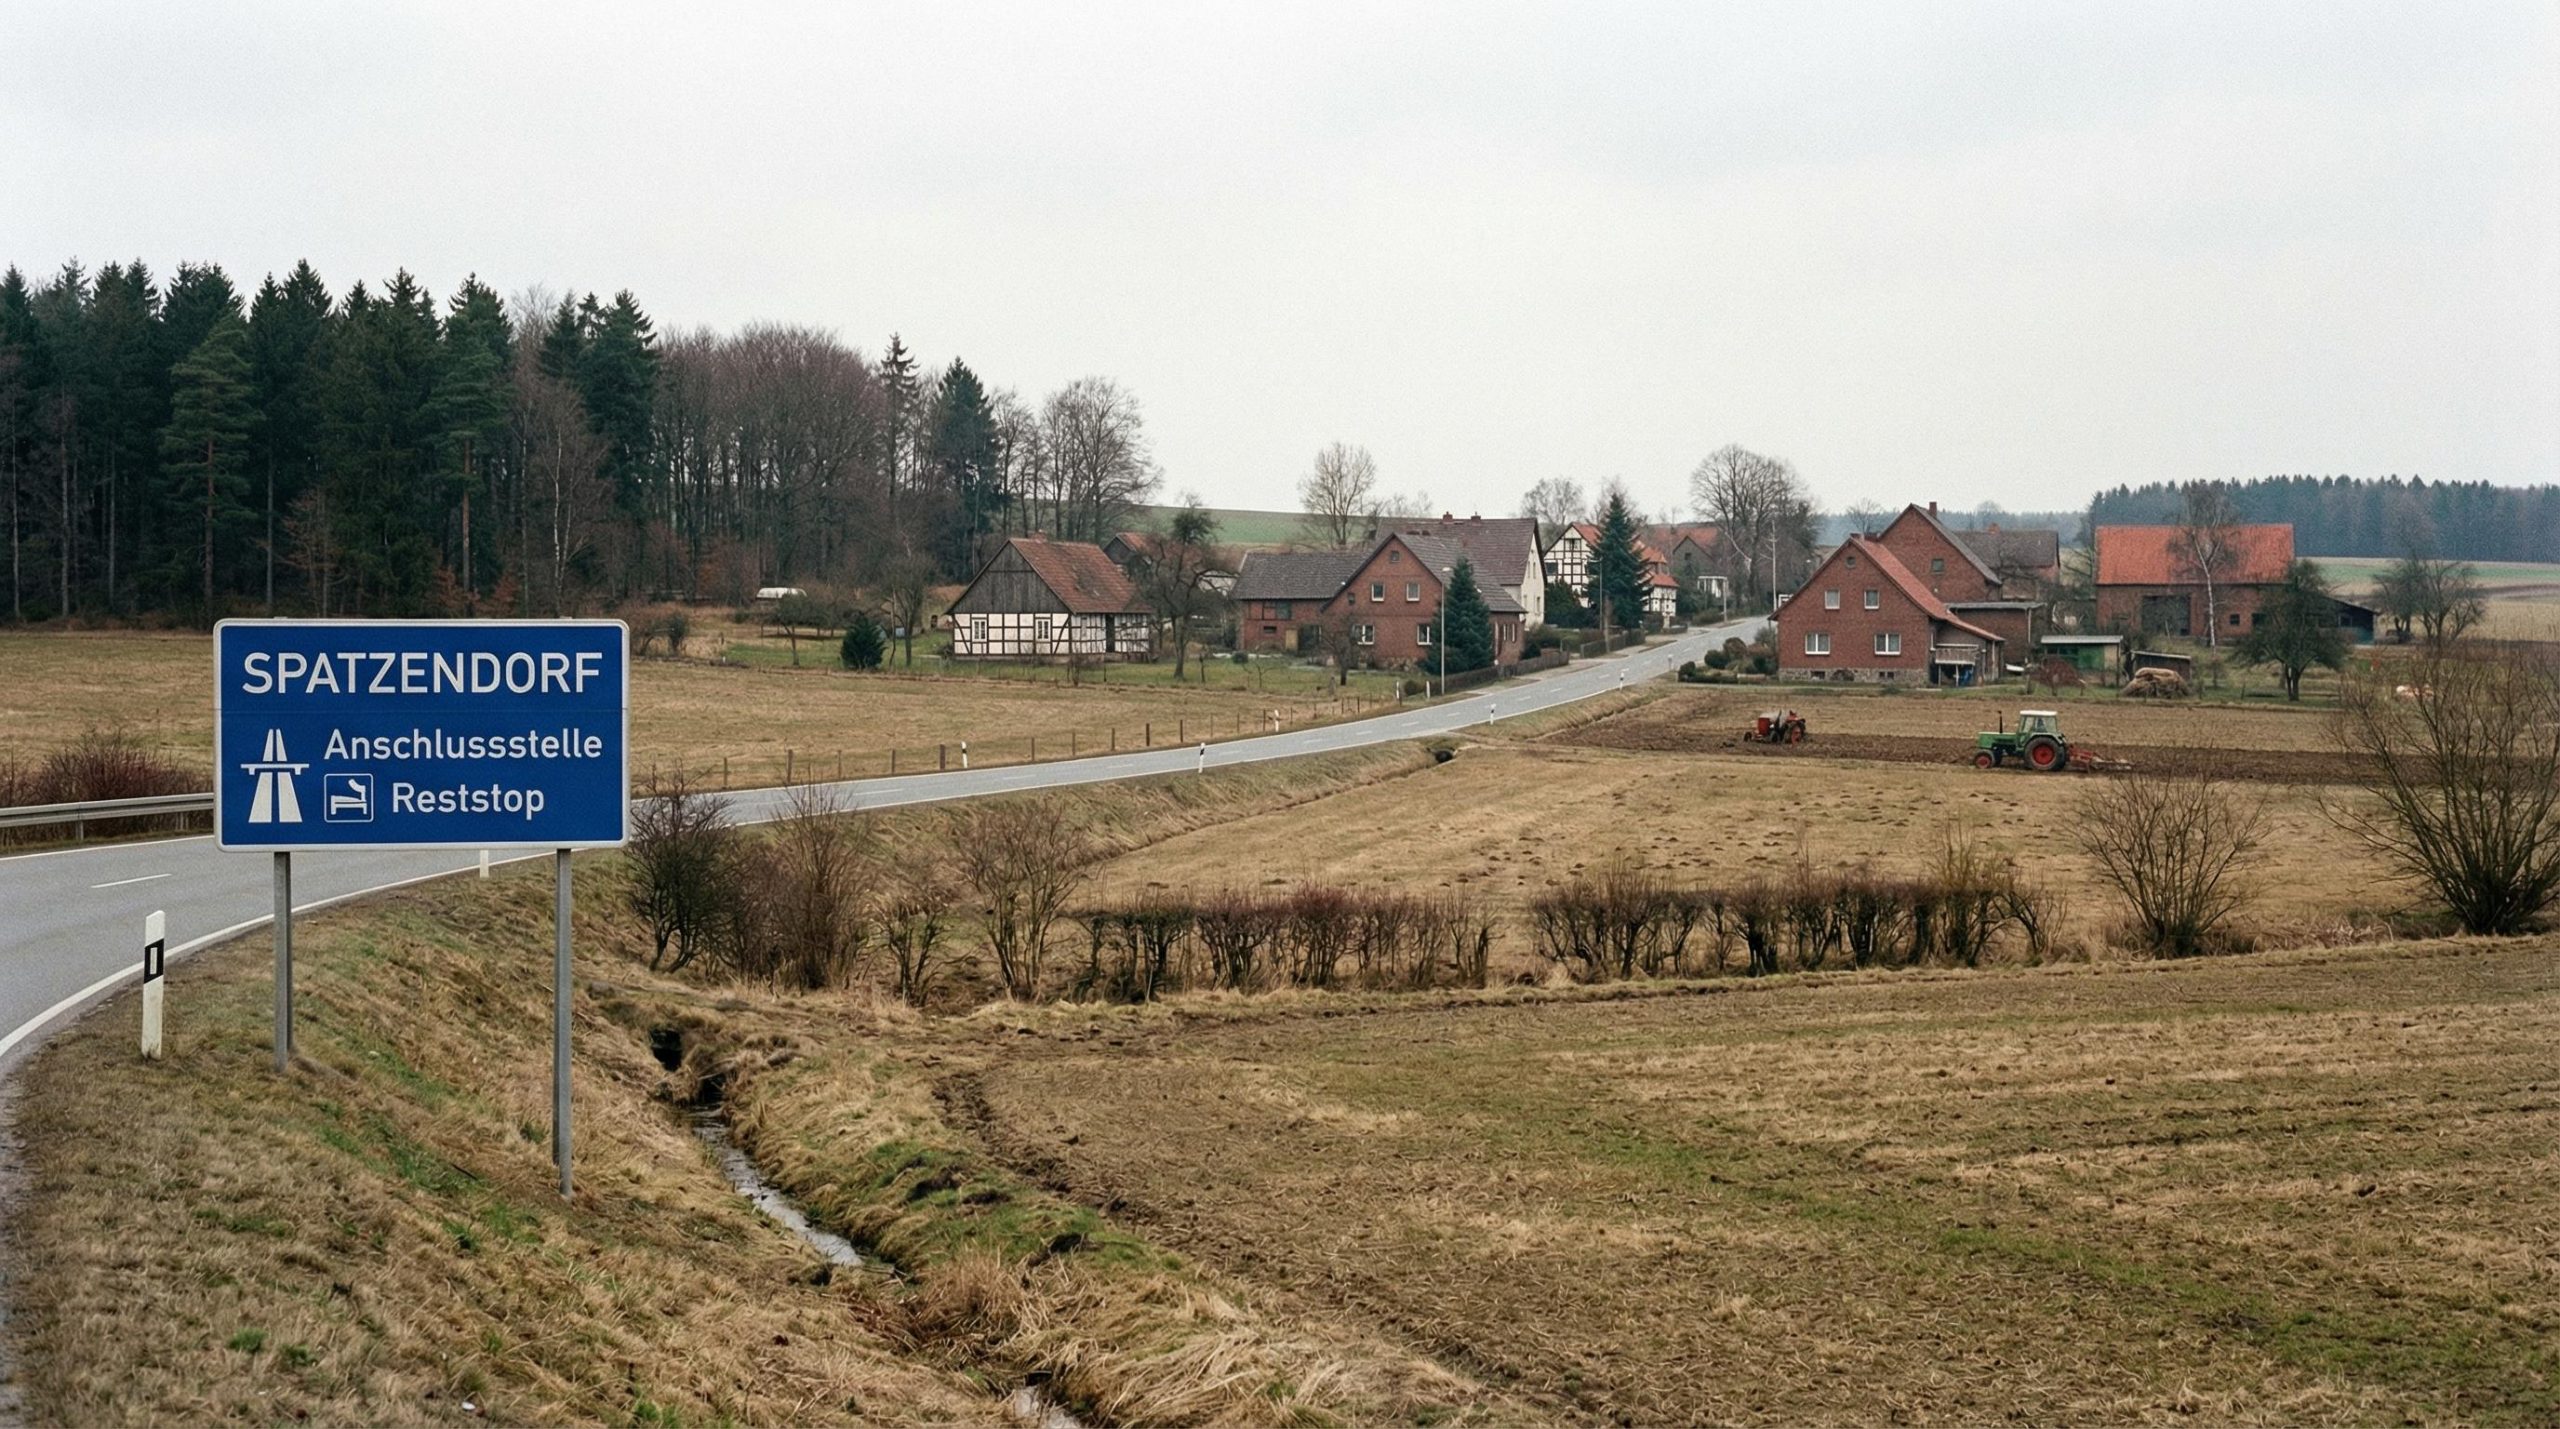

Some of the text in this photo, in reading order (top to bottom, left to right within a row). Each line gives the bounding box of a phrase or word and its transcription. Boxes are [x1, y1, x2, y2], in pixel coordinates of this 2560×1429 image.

[242, 652, 603, 694] SPATZENDORF
[324, 728, 602, 761] Anschlussstelle
[393, 782, 545, 820] Reststop
